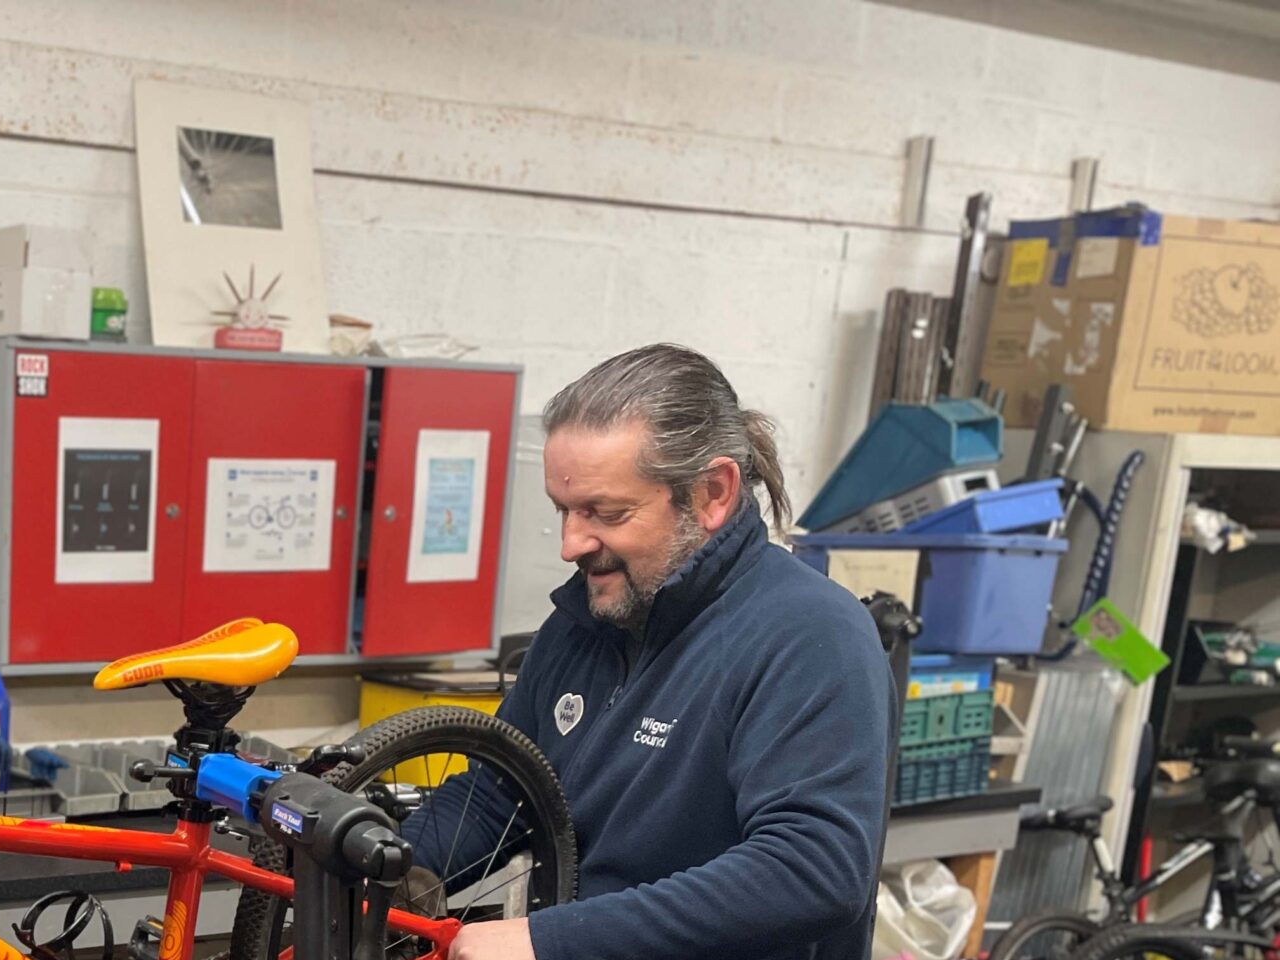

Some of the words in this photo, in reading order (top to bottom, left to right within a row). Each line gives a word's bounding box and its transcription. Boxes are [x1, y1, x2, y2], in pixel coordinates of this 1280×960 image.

[19, 357, 47, 373] ROCK
[1151, 347, 1206, 371] FRUIT
[563, 700, 575, 711] Be
[558, 711, 576, 723] Well
